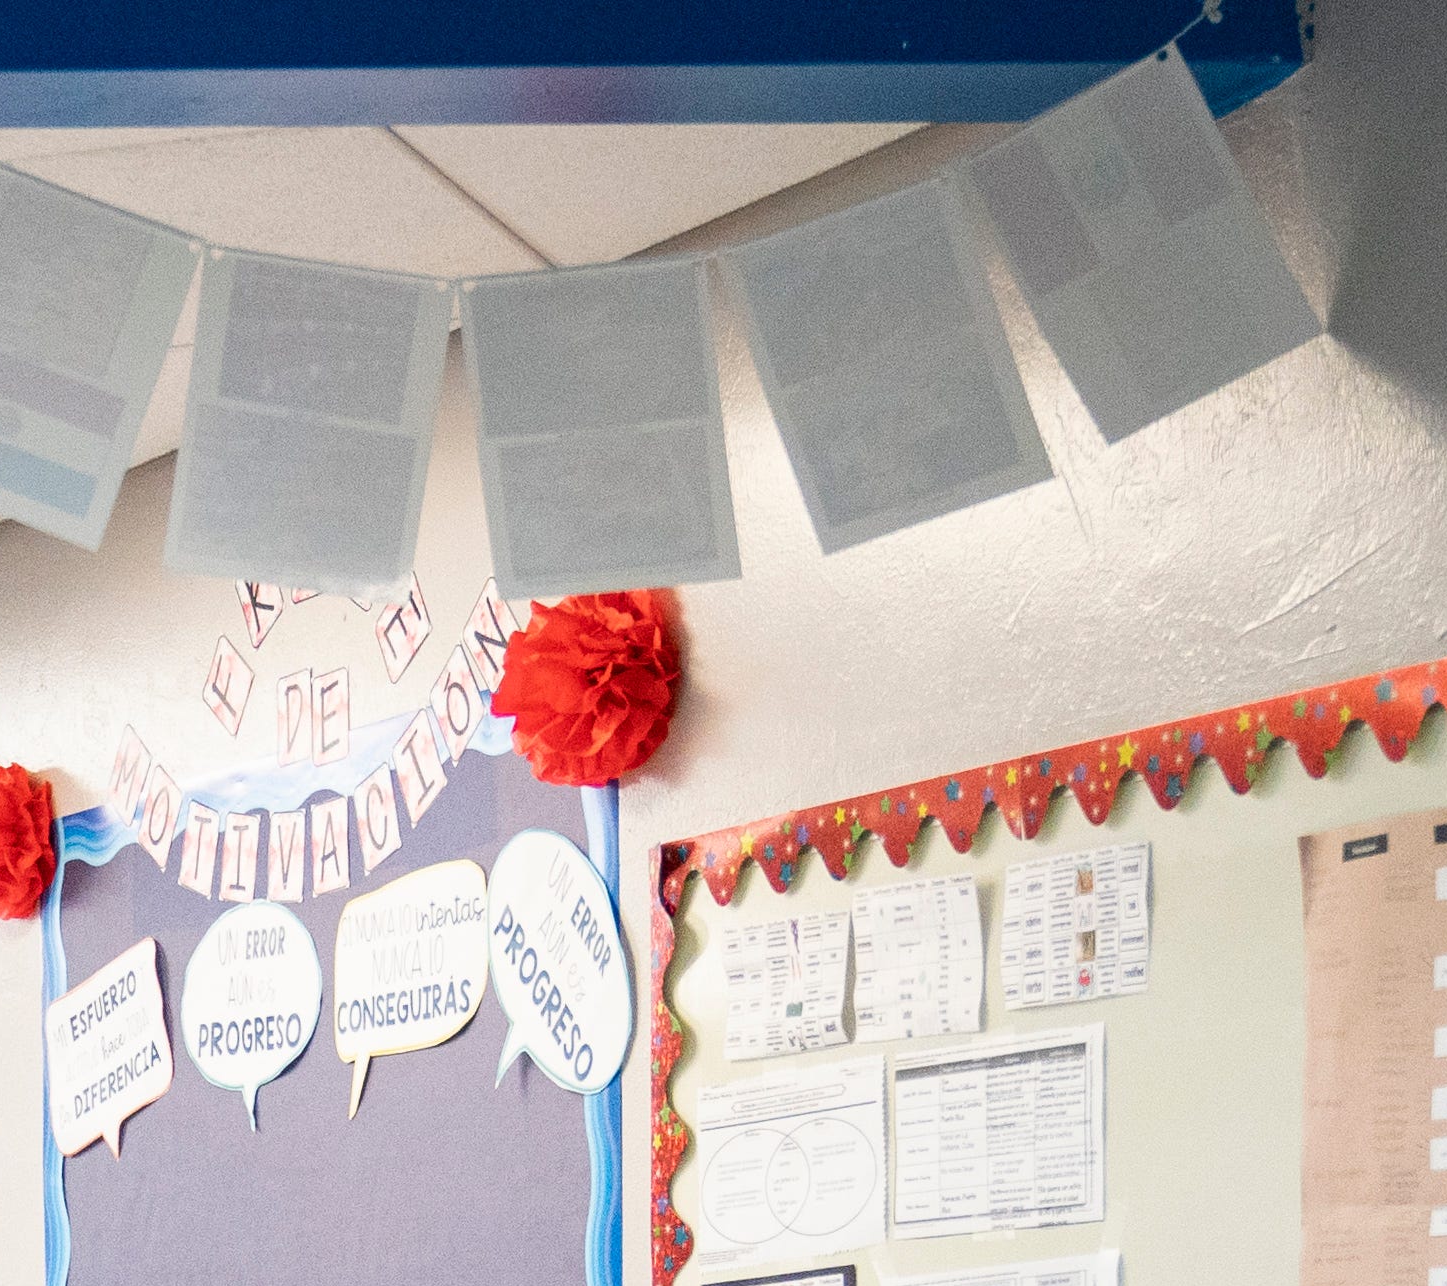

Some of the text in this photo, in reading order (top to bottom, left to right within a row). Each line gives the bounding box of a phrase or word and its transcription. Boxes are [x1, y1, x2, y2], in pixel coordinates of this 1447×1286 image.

[112, 596, 509, 892] MOTIVACIÓN
[282, 678, 342, 754] DE
[245, 925, 286, 961] ERROR
[569, 895, 612, 978] ERROR
[69, 970, 138, 1042] ESFUERZO
[337, 975, 472, 1035] CONSEGUIRÁS
[493, 903, 594, 1081] PROGRESO
[198, 1012, 303, 1058] PROGRESO
[73, 1040, 162, 1120] DIFERENCIA
